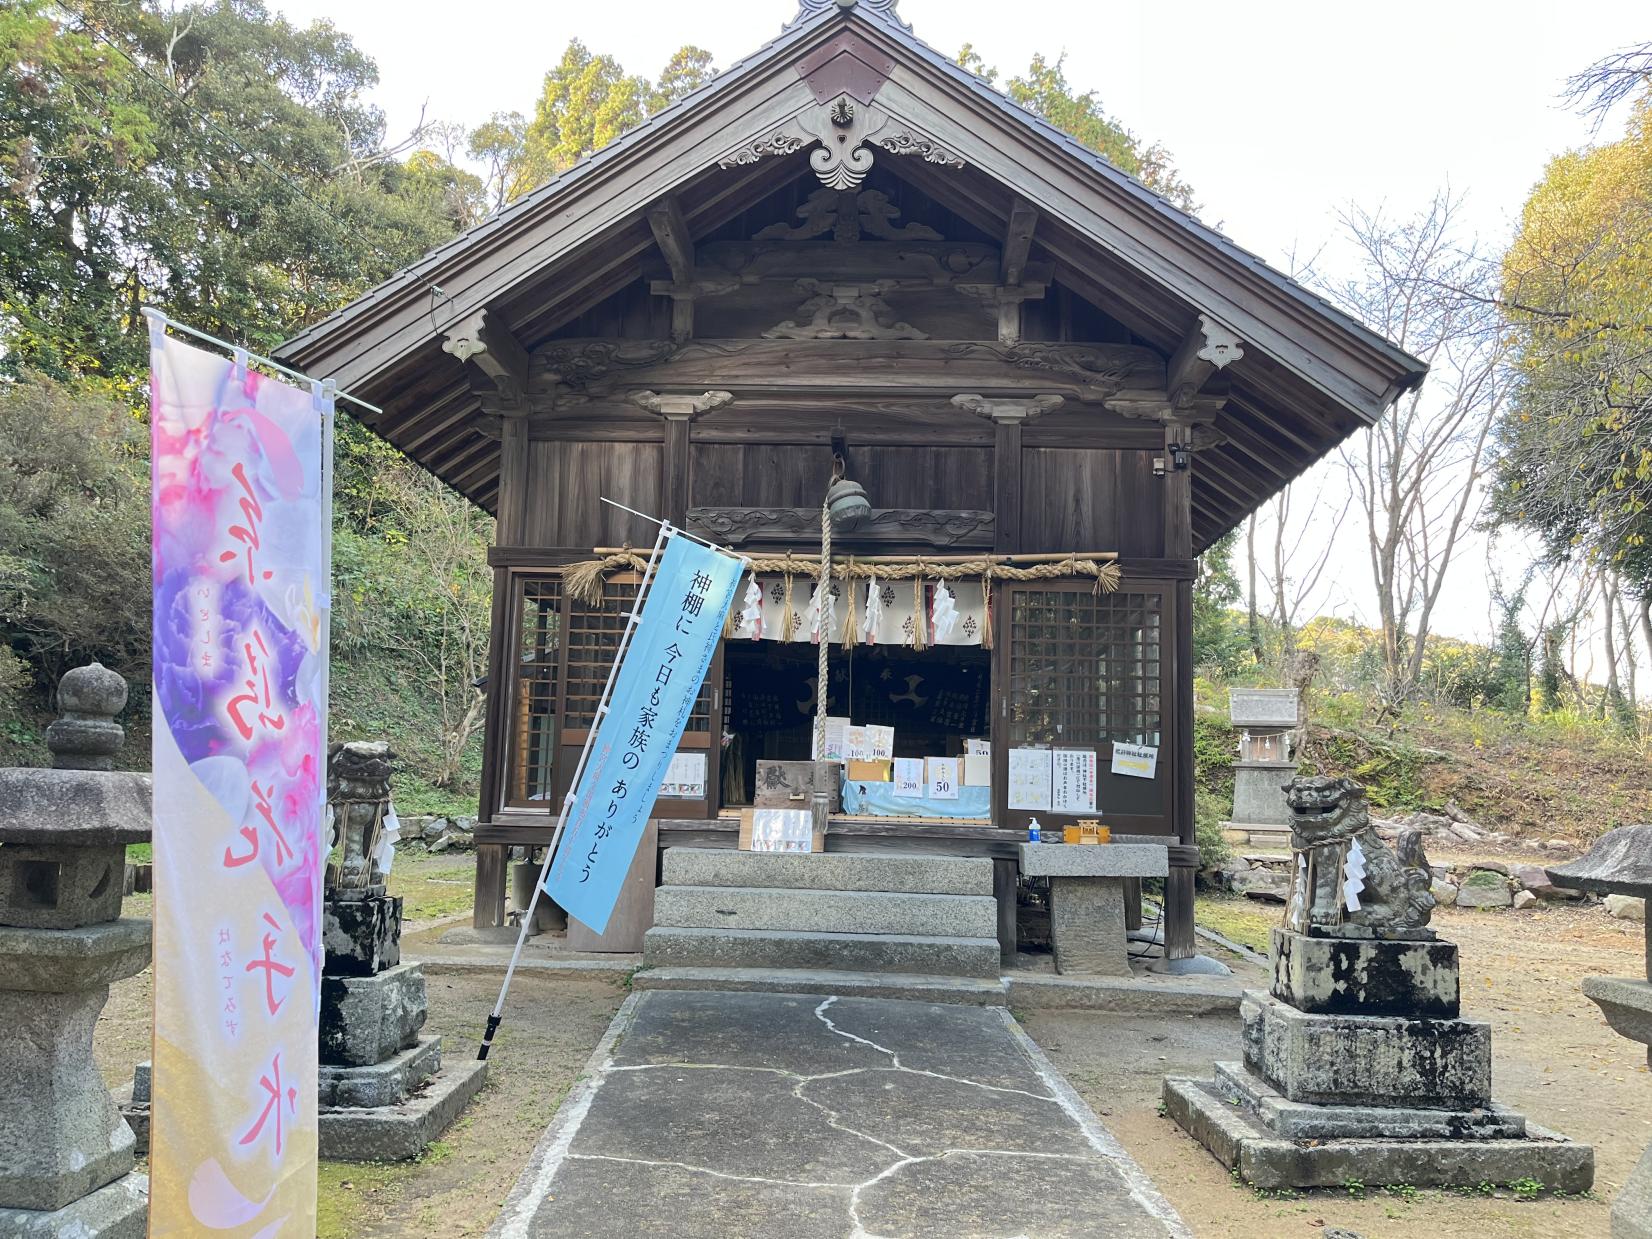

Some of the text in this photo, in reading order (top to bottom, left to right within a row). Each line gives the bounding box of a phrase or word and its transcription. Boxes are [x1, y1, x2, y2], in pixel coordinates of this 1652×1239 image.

[676, 569, 713, 636] 神棚に
[622, 641, 684, 770] 今日も家族の
[903, 781, 917, 790] 200
[936, 781, 950, 793] 50
[579, 778, 628, 884] ありがとう
